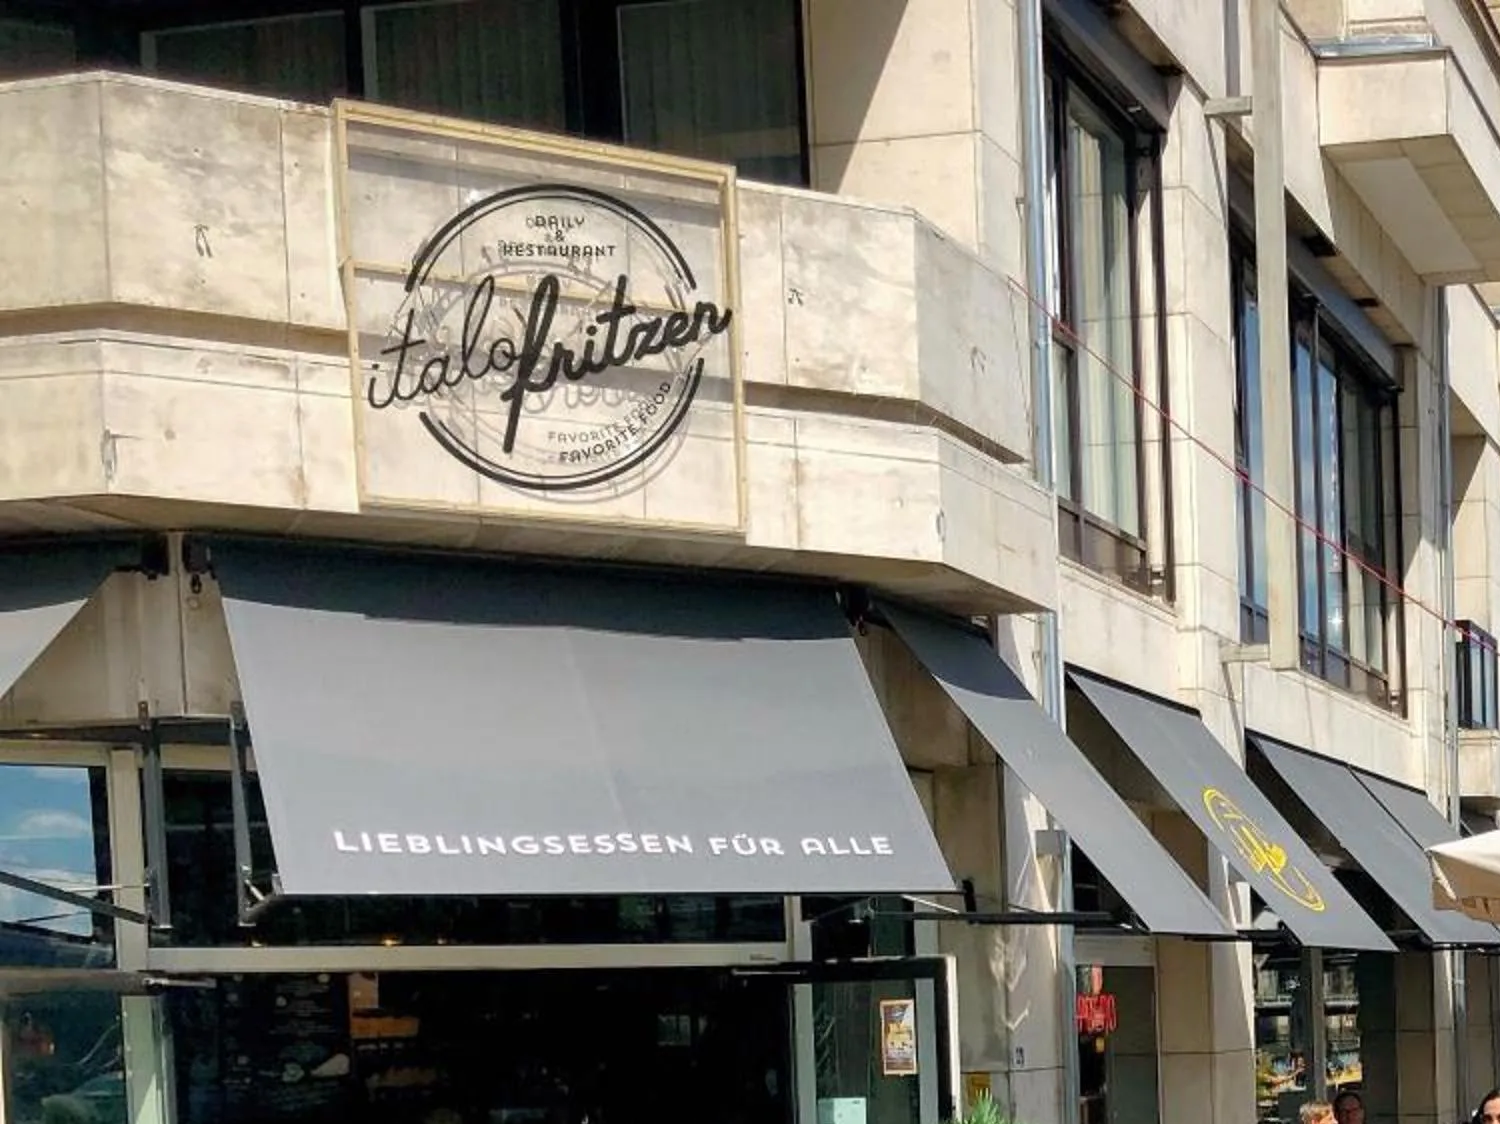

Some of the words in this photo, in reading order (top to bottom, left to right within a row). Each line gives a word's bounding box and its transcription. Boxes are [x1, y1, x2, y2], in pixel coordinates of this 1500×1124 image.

[534, 214, 585, 229] DAILY
[502, 243, 617, 258] RESTAURANT
[560, 423, 640, 463] FAVORITE
[639, 382, 671, 424] FOOD
[333, 830, 694, 856] LIEBLINGSESSEN
[708, 832, 785, 856] FÜR
[801, 836, 894, 856] ALLE
